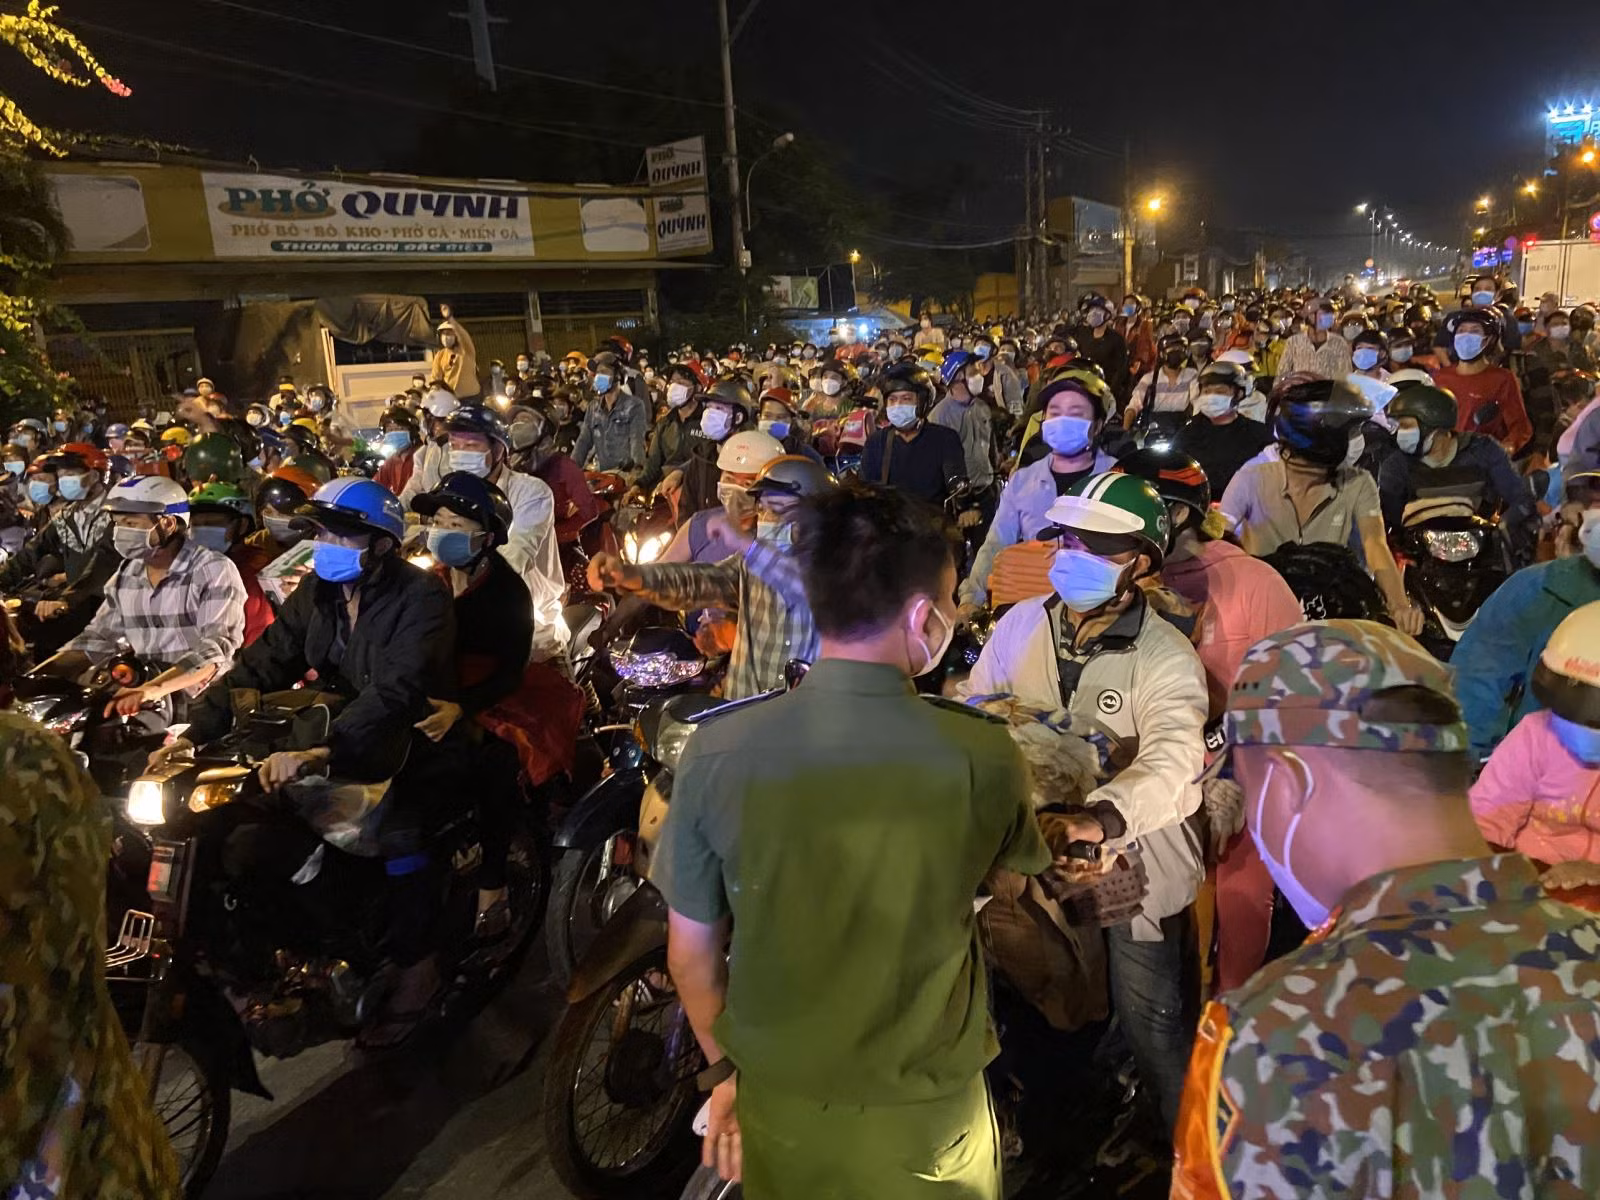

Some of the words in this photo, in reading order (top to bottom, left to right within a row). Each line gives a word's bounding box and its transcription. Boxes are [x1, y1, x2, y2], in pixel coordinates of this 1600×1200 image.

[224, 180, 331, 213] PHỞ
[230, 221, 270, 237] PHỞ
[275, 224, 299, 237] BÒ
[314, 224, 338, 238] BÒ
[345, 226, 381, 238] KHO
[392, 224, 424, 238] PHỞ
[427, 225, 450, 239] GÀ
[459, 224, 496, 239] MIẾN
